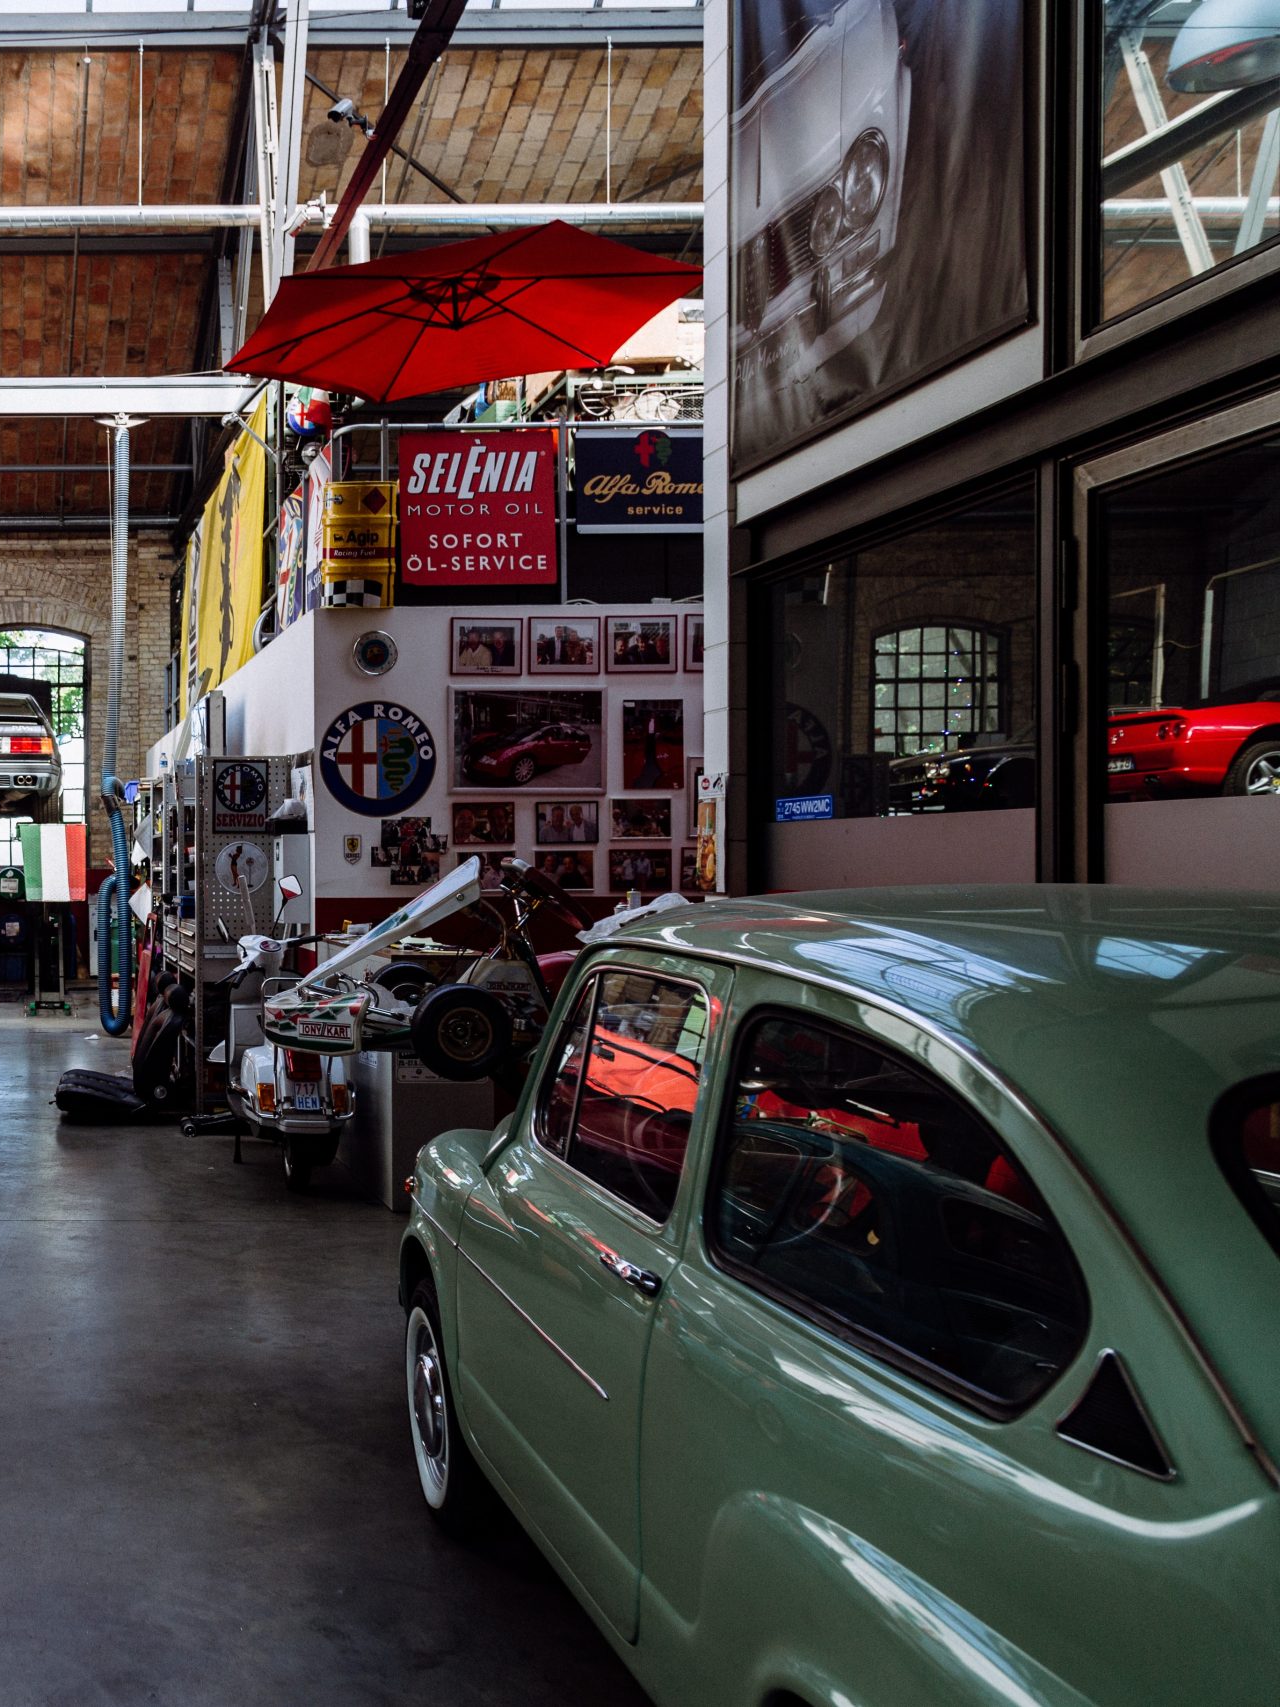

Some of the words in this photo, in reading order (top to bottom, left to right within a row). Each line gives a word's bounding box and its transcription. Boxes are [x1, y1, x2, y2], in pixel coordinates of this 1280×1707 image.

[407, 438, 538, 500] SELÈNIA
[583, 473, 640, 504] Alfa
[407, 504, 490, 516] MOTOR
[505, 503, 543, 515] OIL
[627, 504, 683, 515] service
[346, 529, 380, 547] Agip
[429, 533, 523, 549] SOFORT
[333, 549, 358, 558] Racing
[360, 549, 376, 557] Fuel
[407, 554, 548, 572] ÖL-SERVICE
[322, 710, 363, 762] ALFA
[373, 703, 434, 760] ROMEO
[216, 813, 266, 827] SERVIZIO
[295, 1084, 315, 1095] 717
[298, 1096, 317, 1109] HEN
